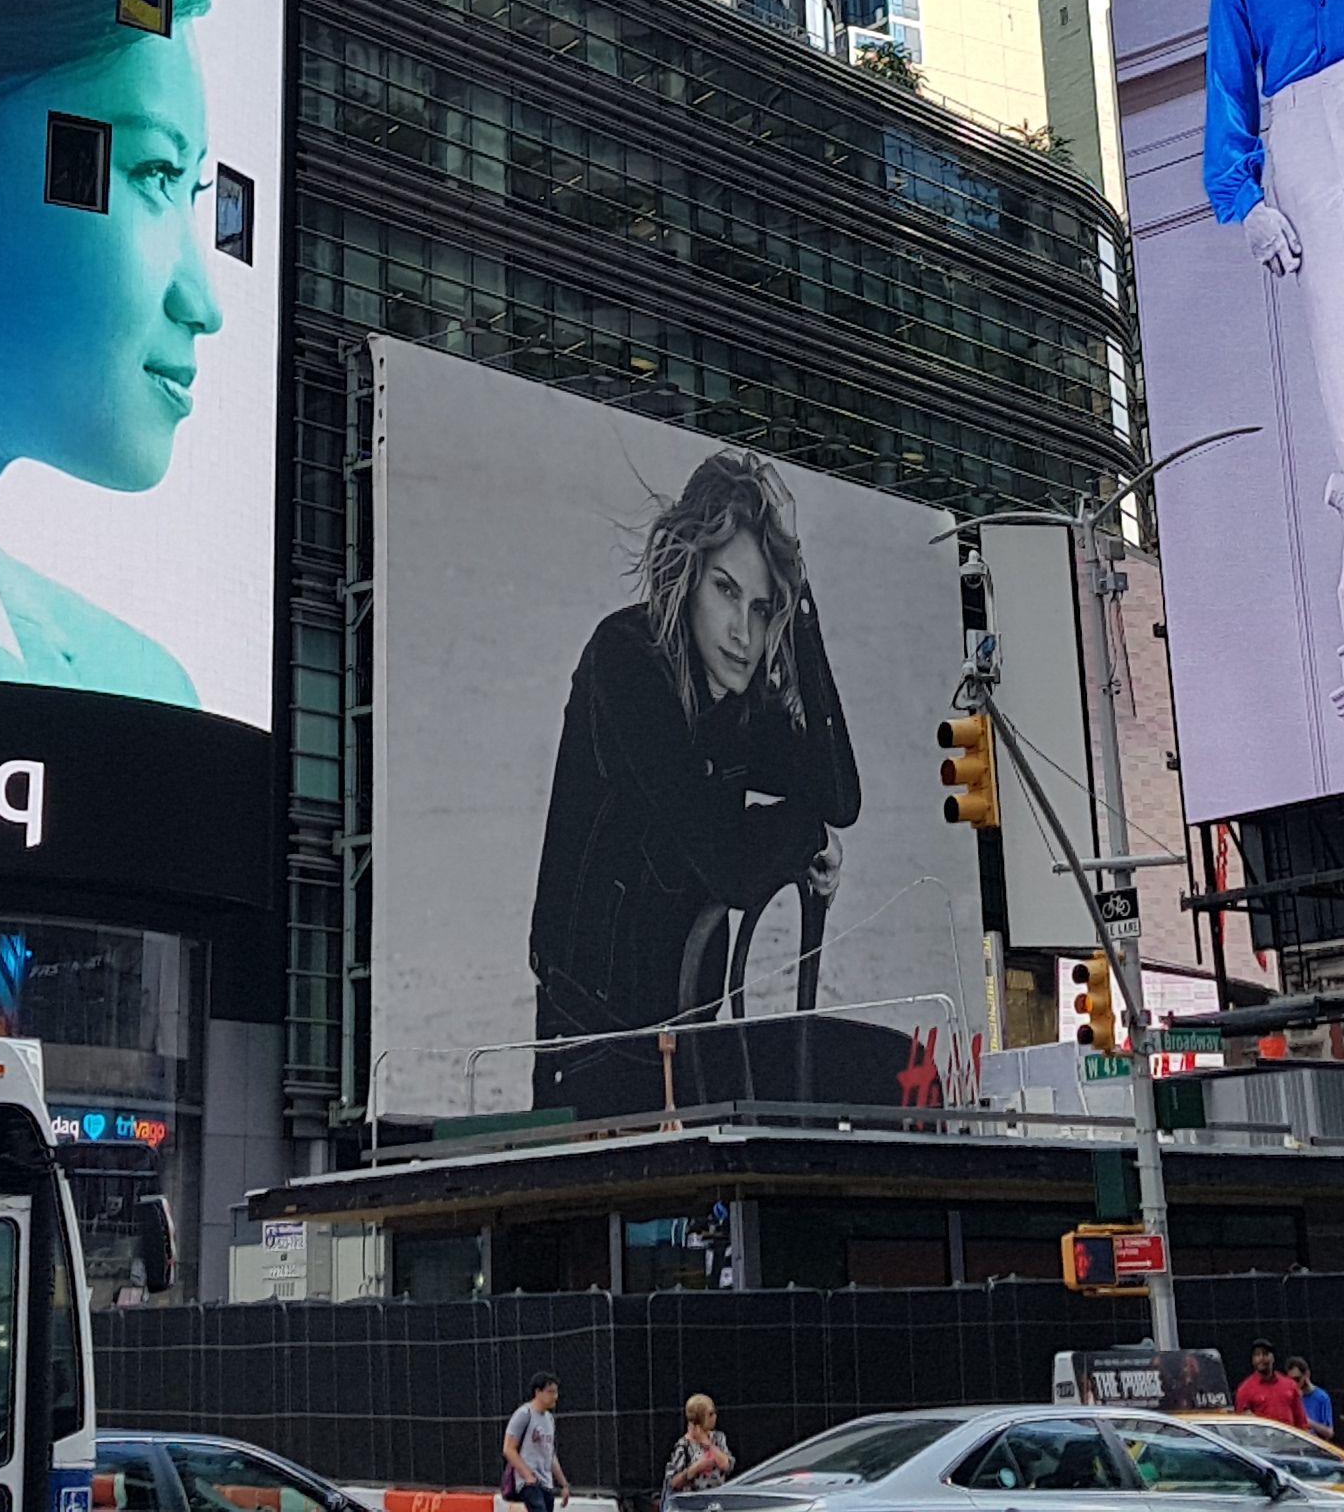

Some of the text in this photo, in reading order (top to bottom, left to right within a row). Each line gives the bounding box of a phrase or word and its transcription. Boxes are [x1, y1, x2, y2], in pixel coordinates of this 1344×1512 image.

[1164, 1031, 1220, 1052] Broadway
[1087, 1056, 1098, 1079] W
[1104, 1056, 1118, 1076] 43
[116, 1114, 168, 1148] trivago
[1093, 1370, 1121, 1398] THE
[1121, 1370, 1166, 1399] PURGE
